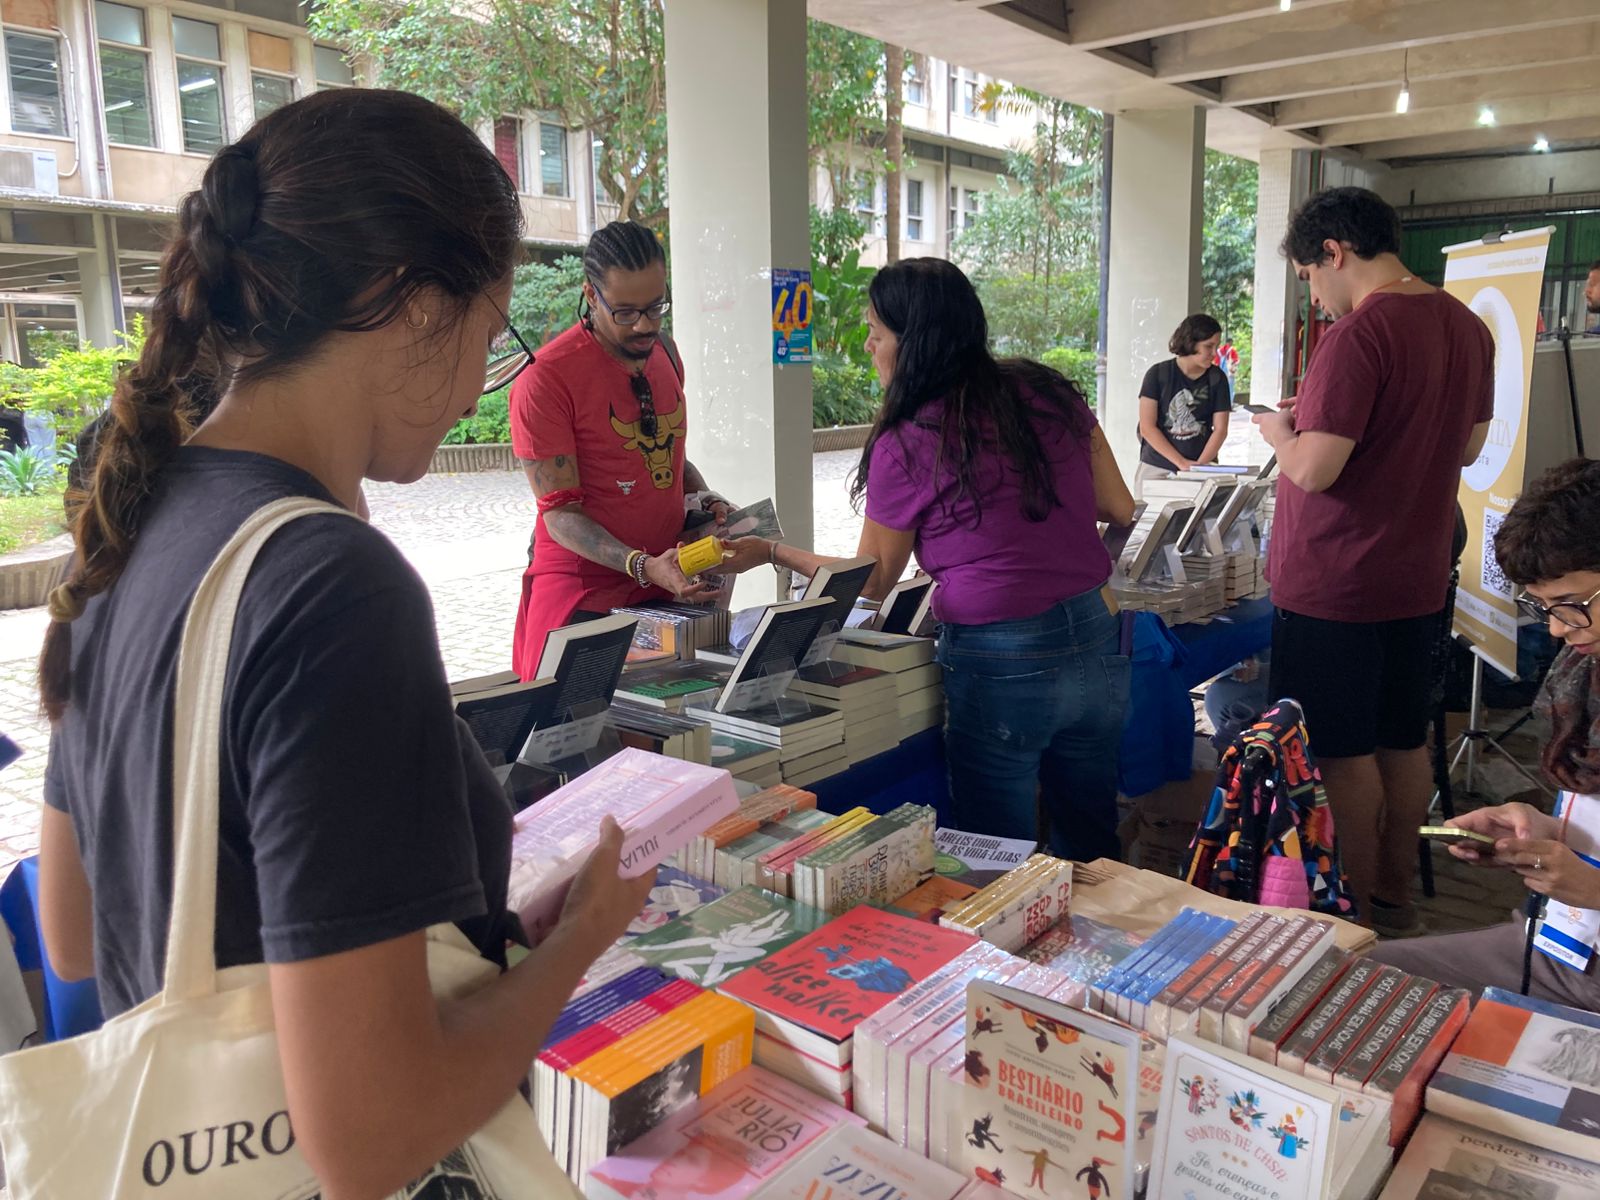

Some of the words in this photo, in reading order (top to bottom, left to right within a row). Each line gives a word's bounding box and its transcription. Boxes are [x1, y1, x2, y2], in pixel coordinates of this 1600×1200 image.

[619, 834, 660, 870] JULIA
[755, 957, 832, 990] alice
[762, 982, 869, 1026] walker
[998, 1058, 1083, 1115] BESTIÁRIO
[998, 1082, 1083, 1131] BRASILEIRO
[732, 1096, 804, 1141] JULIA
[736, 1122, 788, 1153] RIO
[1184, 1125, 1232, 1143] SANTOS
[142, 1109, 296, 1187] OURO
[1459, 1134, 1523, 1158] perder
